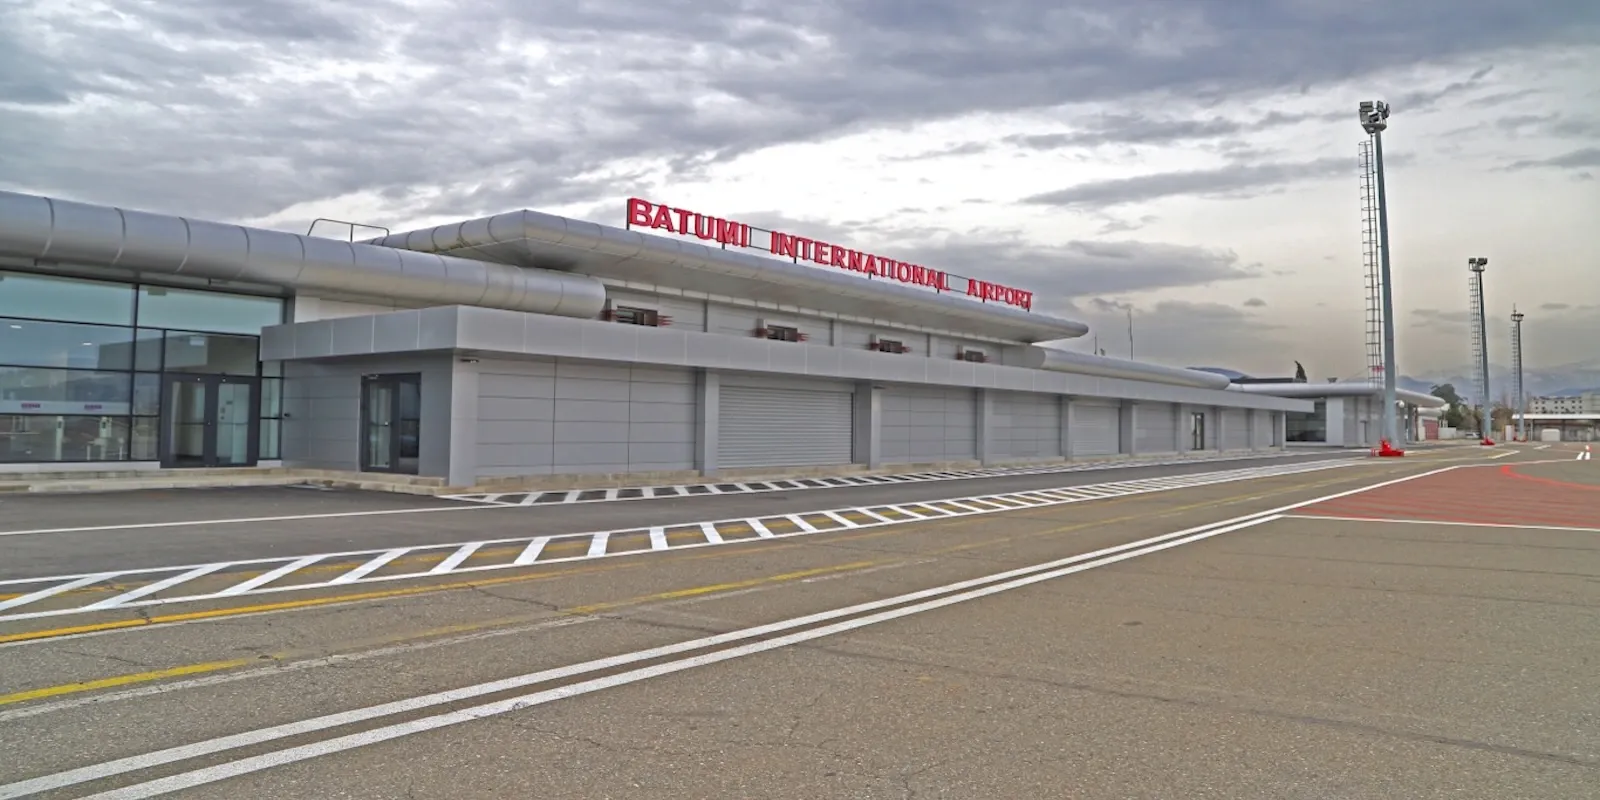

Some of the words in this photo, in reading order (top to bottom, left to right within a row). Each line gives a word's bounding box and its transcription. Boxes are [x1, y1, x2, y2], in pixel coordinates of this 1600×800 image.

[628, 197, 749, 248] BATUMI
[770, 230, 950, 292] INTERNATIONAL
[967, 278, 1034, 310] AIRPORT
